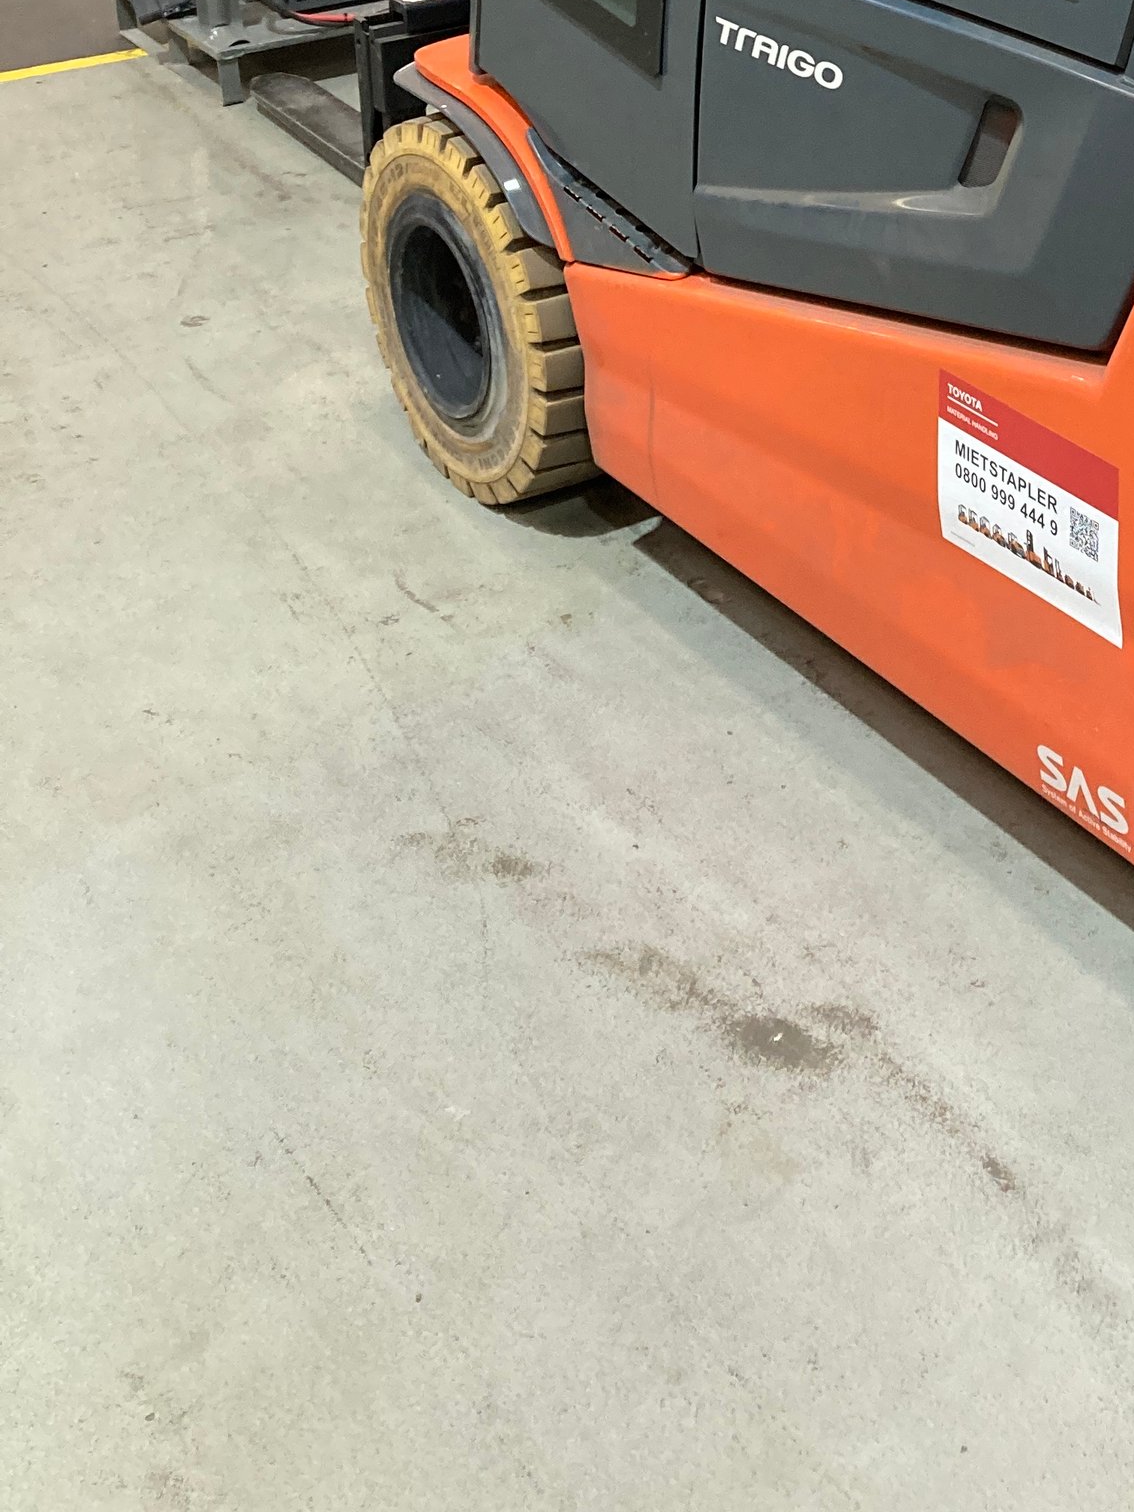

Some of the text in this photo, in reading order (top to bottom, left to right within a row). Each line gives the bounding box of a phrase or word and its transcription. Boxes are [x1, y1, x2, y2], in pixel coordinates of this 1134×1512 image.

[715, 15, 844, 90] TRAIGO
[947, 382, 983, 413] TOYOTA
[954, 439, 1058, 515] MIETSTAPLER
[954, 462, 1059, 537] 0800 999 444 9
[1036, 744, 1129, 835] SAS
